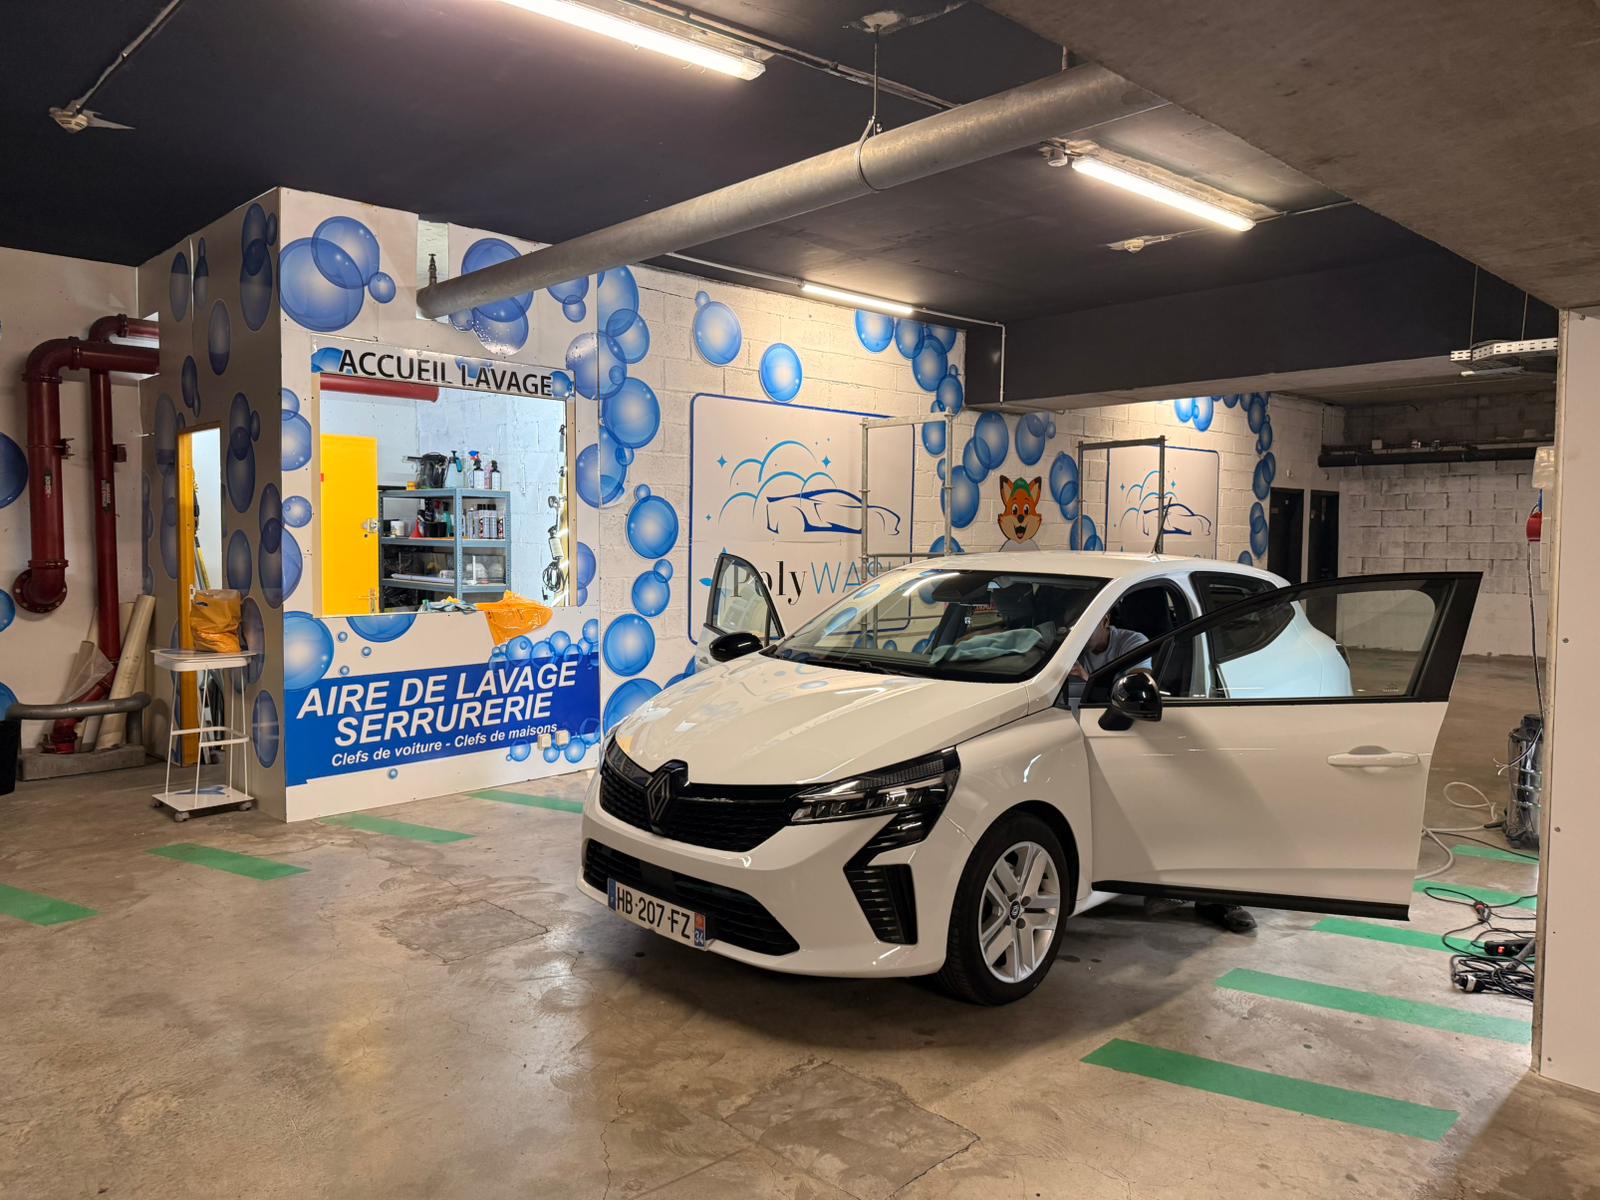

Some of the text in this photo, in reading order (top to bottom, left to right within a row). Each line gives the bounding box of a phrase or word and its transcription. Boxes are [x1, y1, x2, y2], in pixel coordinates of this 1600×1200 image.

[338, 349, 553, 396] ACCUEIL LAVAGE
[296, 661, 578, 720] AIRE DE LAVAGE
[331, 752, 369, 768] Clefs
[372, 746, 391, 761] de
[394, 740, 443, 758] voiture
[454, 733, 487, 749] Clefs
[489, 729, 506, 743] de
[508, 722, 558, 739] maisons
[334, 692, 553, 747] SERRURERIE
